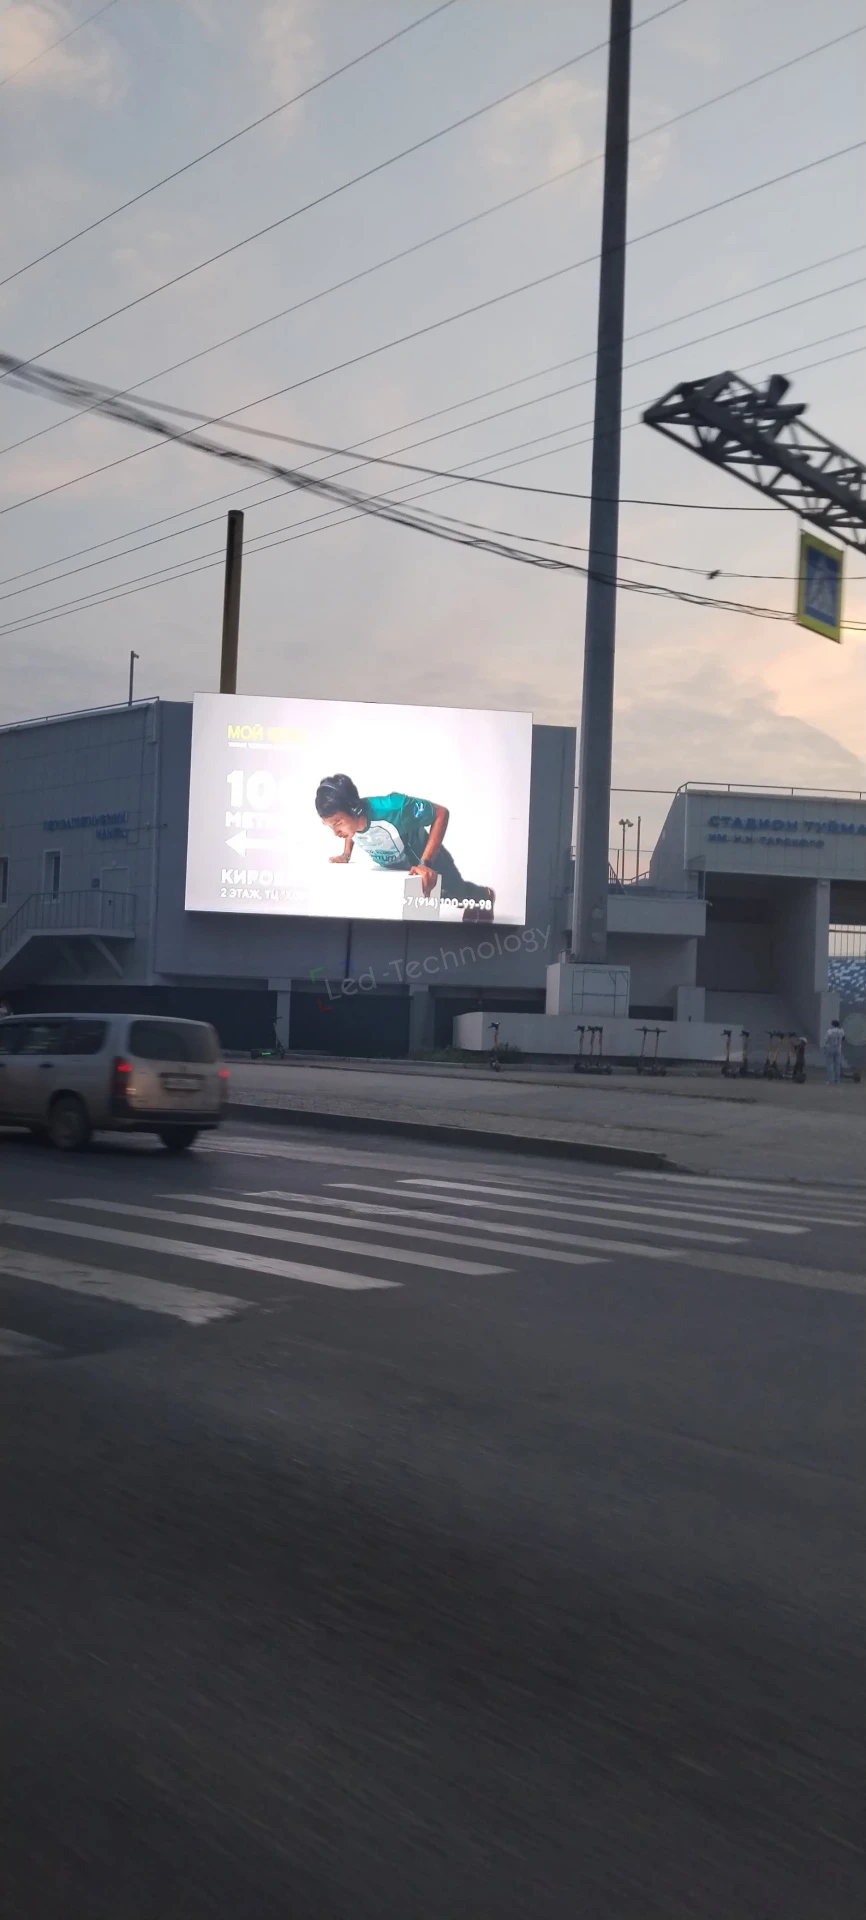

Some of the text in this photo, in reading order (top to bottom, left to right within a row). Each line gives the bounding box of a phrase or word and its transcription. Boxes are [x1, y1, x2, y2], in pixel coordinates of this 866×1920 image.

[227, 724, 264, 740] МОЙ
[708, 816, 798, 831] СТАДИОН
[220, 888, 227, 897] 2
